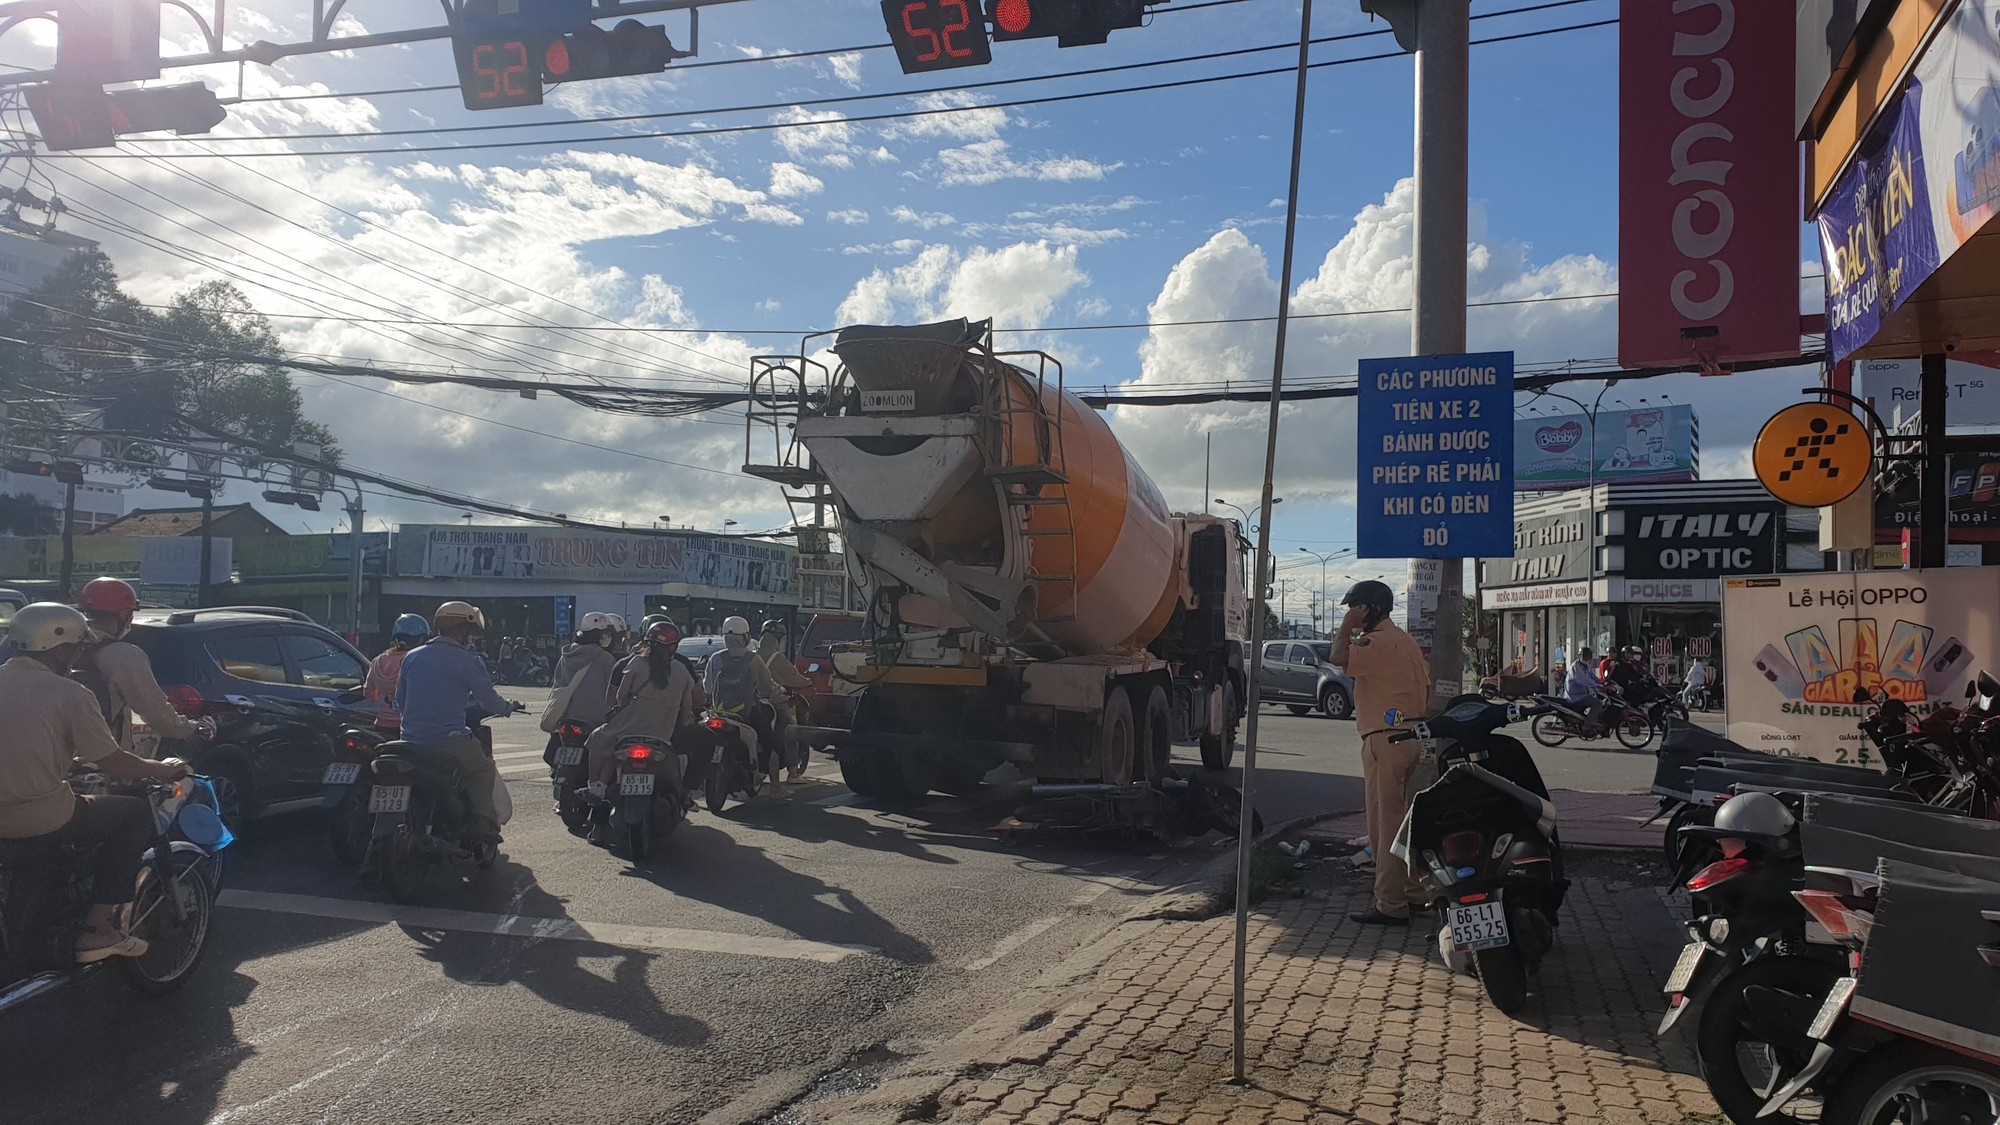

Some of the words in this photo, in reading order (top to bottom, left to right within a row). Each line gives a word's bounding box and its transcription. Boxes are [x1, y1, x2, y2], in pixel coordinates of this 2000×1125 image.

[902, 0, 973, 62] 52
[472, 41, 527, 99] 52
[1868, 363, 1899, 372] oppo
[1377, 368, 1414, 391] CÁC
[1420, 366, 1496, 389] PHƯƠNG
[1955, 383, 1966, 398] T
[1970, 380, 1983, 388] 5G
[863, 394, 913, 407] ZOOMLION
[1392, 398, 1433, 425] TIỆN
[1439, 400, 1462, 419] XE
[1469, 399, 1480, 418] 2
[1383, 431, 1433, 453] BÁNH
[1439, 430, 1490, 454] ĐƯỢC
[1538, 430, 1579, 447] Bobby
[1373, 462, 1420, 484] PHÉP
[1426, 459, 1450, 483] RẼ
[1456, 456, 1500, 482] PHẢI
[1383, 496, 1414, 516] KHI
[1420, 492, 1445, 514] CÓ
[1451, 493, 1489, 514] ĐÈN
[1638, 512, 1771, 538] ITALY
[1895, 512, 1921, 525] Điệ
[473, 531, 503, 545] TRANG
[505, 531, 528, 544] NAM
[1423, 521, 1448, 547] ĐỎ
[535, 537, 628, 567] TRUNG
[1659, 548, 1753, 569] OPTIC
[1511, 553, 1566, 581] ITALY
[1630, 584, 1693, 598] POLICE
[1789, 589, 1813, 607] Lễ
[1820, 589, 1854, 609] Hội
[1860, 587, 1927, 606] OPPO
[1690, 637, 1711, 657] CHO
[1820, 705, 1861, 718] DEAL
[1835, 747, 1870, 764] 2.5
[626, 775, 649, 784] 65-H1
[1456, 904, 1494, 924] 66-L1
[1454, 920, 1504, 942] 555.25
